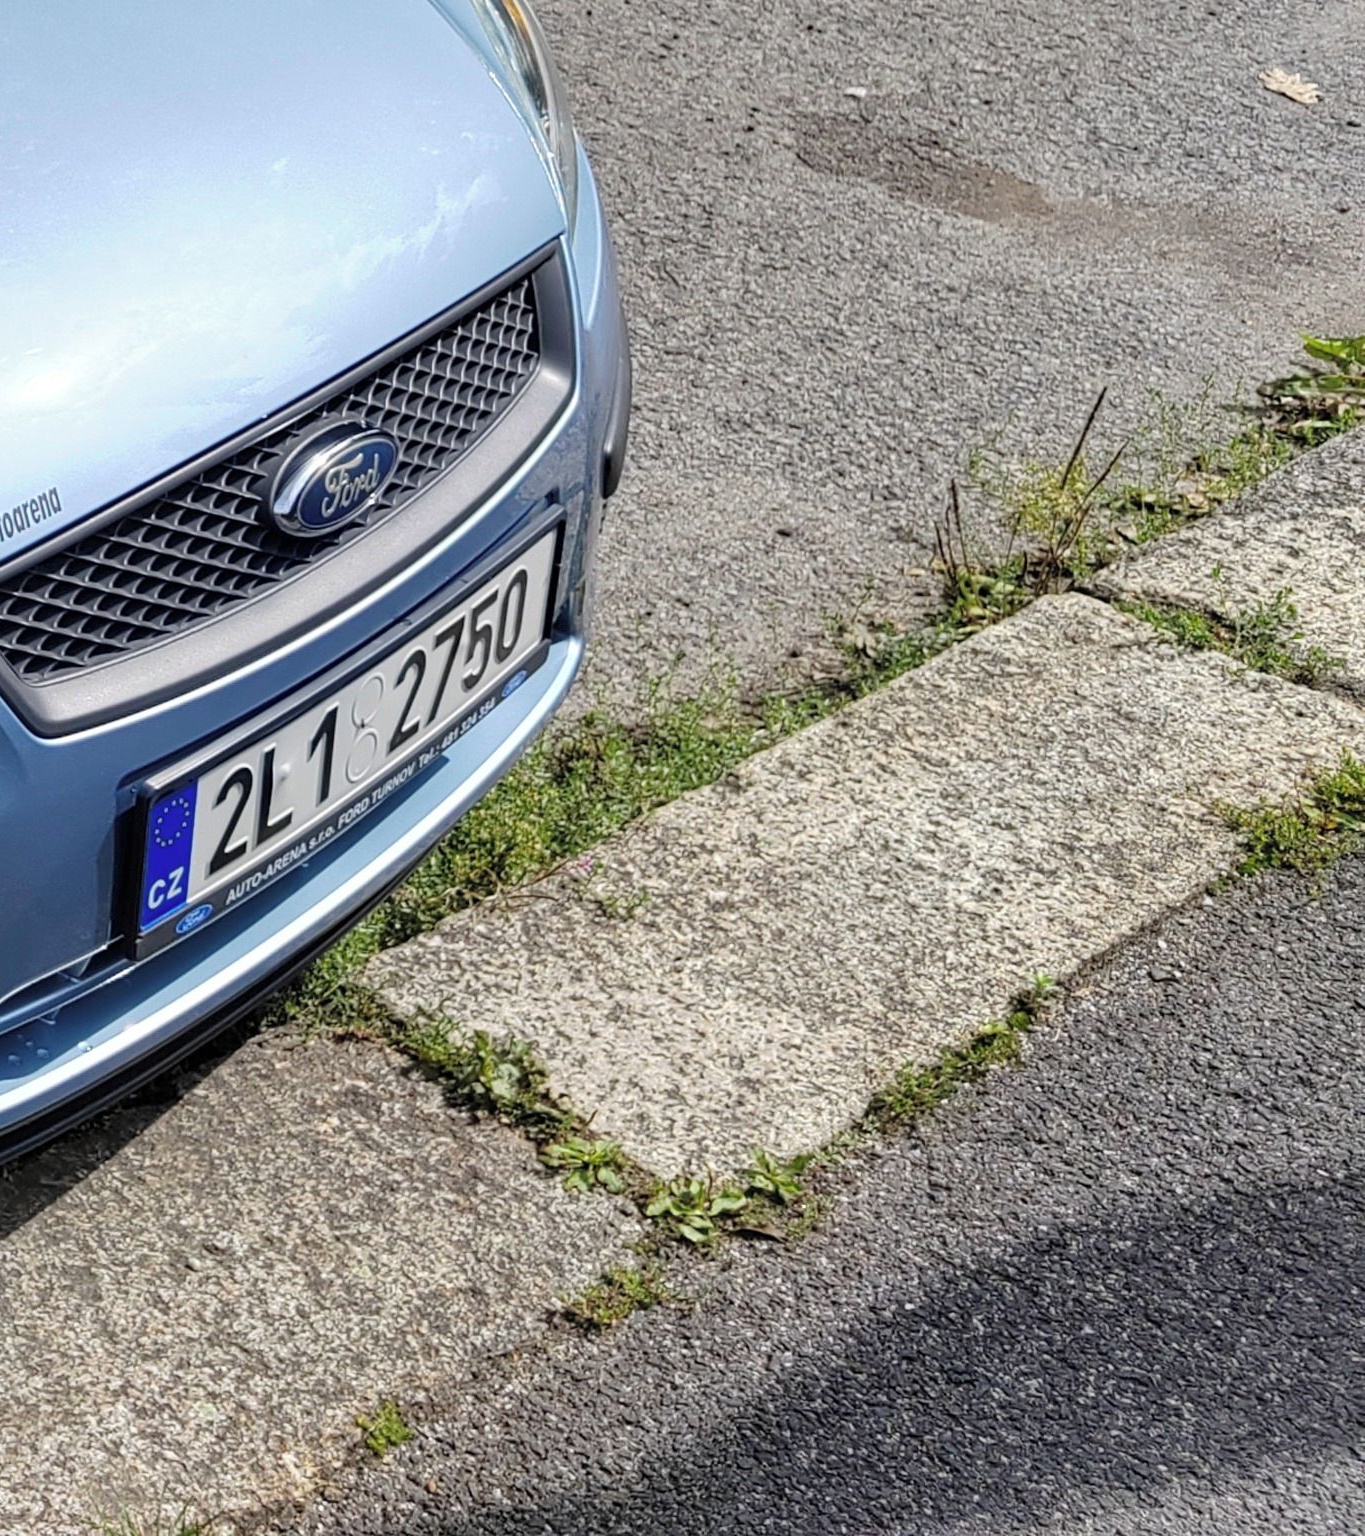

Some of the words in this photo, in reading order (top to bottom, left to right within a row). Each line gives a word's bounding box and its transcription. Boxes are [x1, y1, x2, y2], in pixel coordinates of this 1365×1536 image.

[321, 452, 381, 519] Ford
[147, 866, 185, 910] CZ
[205, 703, 339, 878] 2L1
[387, 566, 529, 756] 2750
[225, 842, 307, 905] AUTO-ARENA
[308, 826, 335, 850] s.r.o.
[337, 797, 370, 830] FORD
[371, 761, 416, 805] TURNOV
